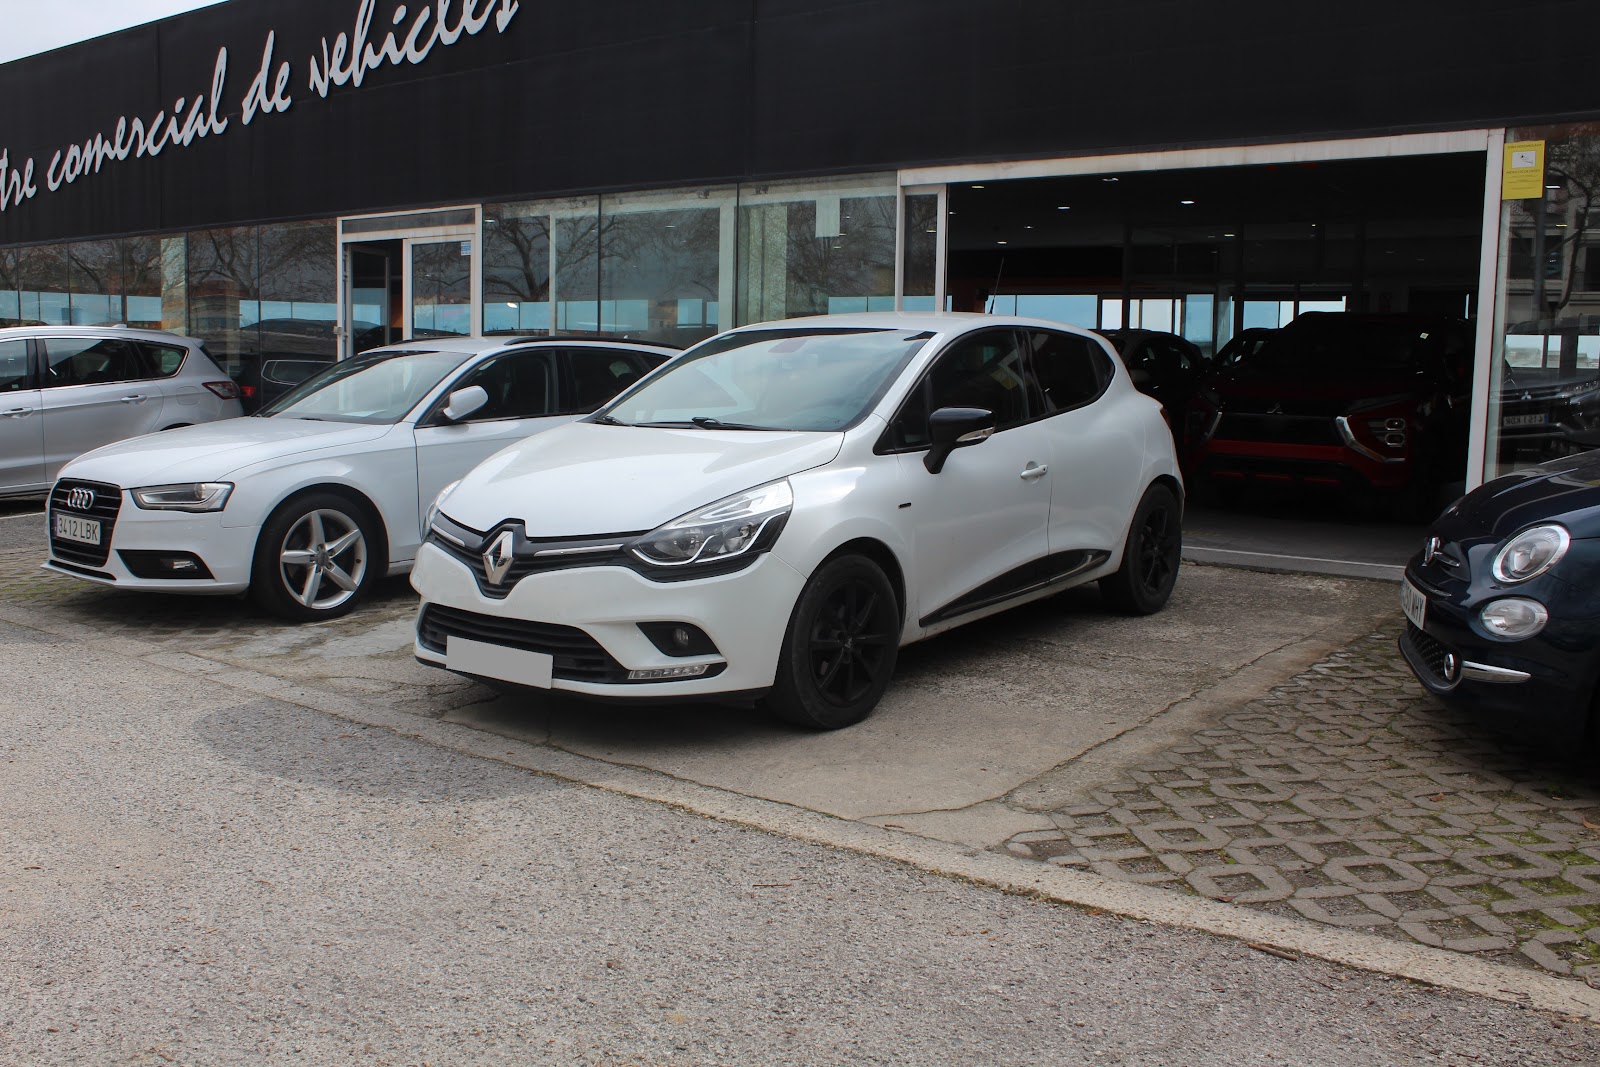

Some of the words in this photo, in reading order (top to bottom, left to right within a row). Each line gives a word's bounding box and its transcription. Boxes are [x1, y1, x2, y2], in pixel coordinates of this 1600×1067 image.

[46, 46, 228, 192] comercial
[241, 29, 292, 126] de
[58, 517, 78, 537] 3412
[80, 521, 98, 542] LBK
